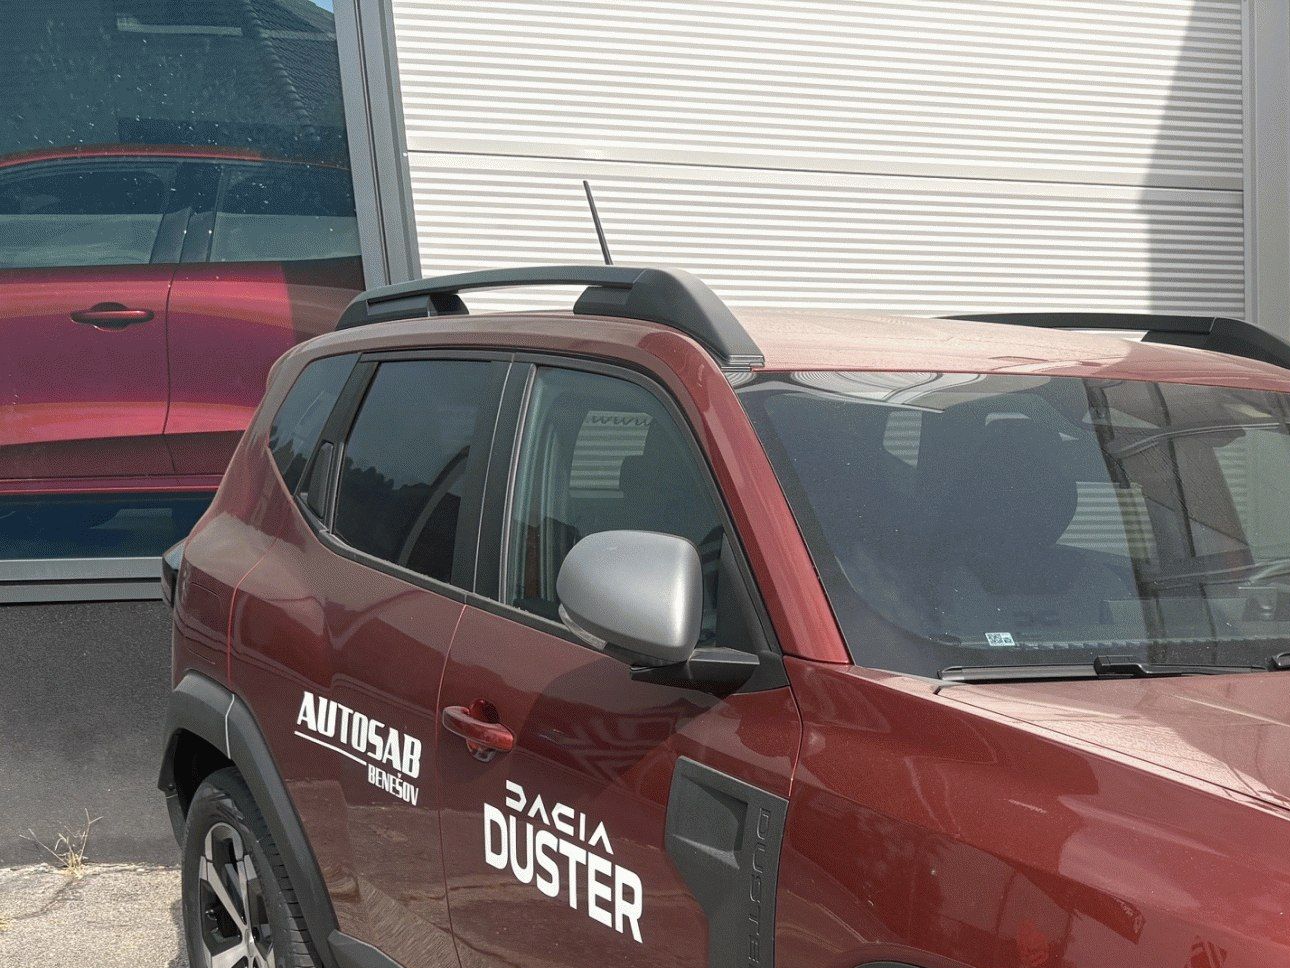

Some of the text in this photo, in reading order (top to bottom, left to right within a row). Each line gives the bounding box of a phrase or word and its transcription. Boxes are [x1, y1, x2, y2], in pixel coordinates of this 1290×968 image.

[297, 691, 423, 779] AUTOSAB
[367, 763, 419, 806] BENEŠOV
[505, 779, 615, 855] DACIA
[483, 802, 644, 944] DUSTER
